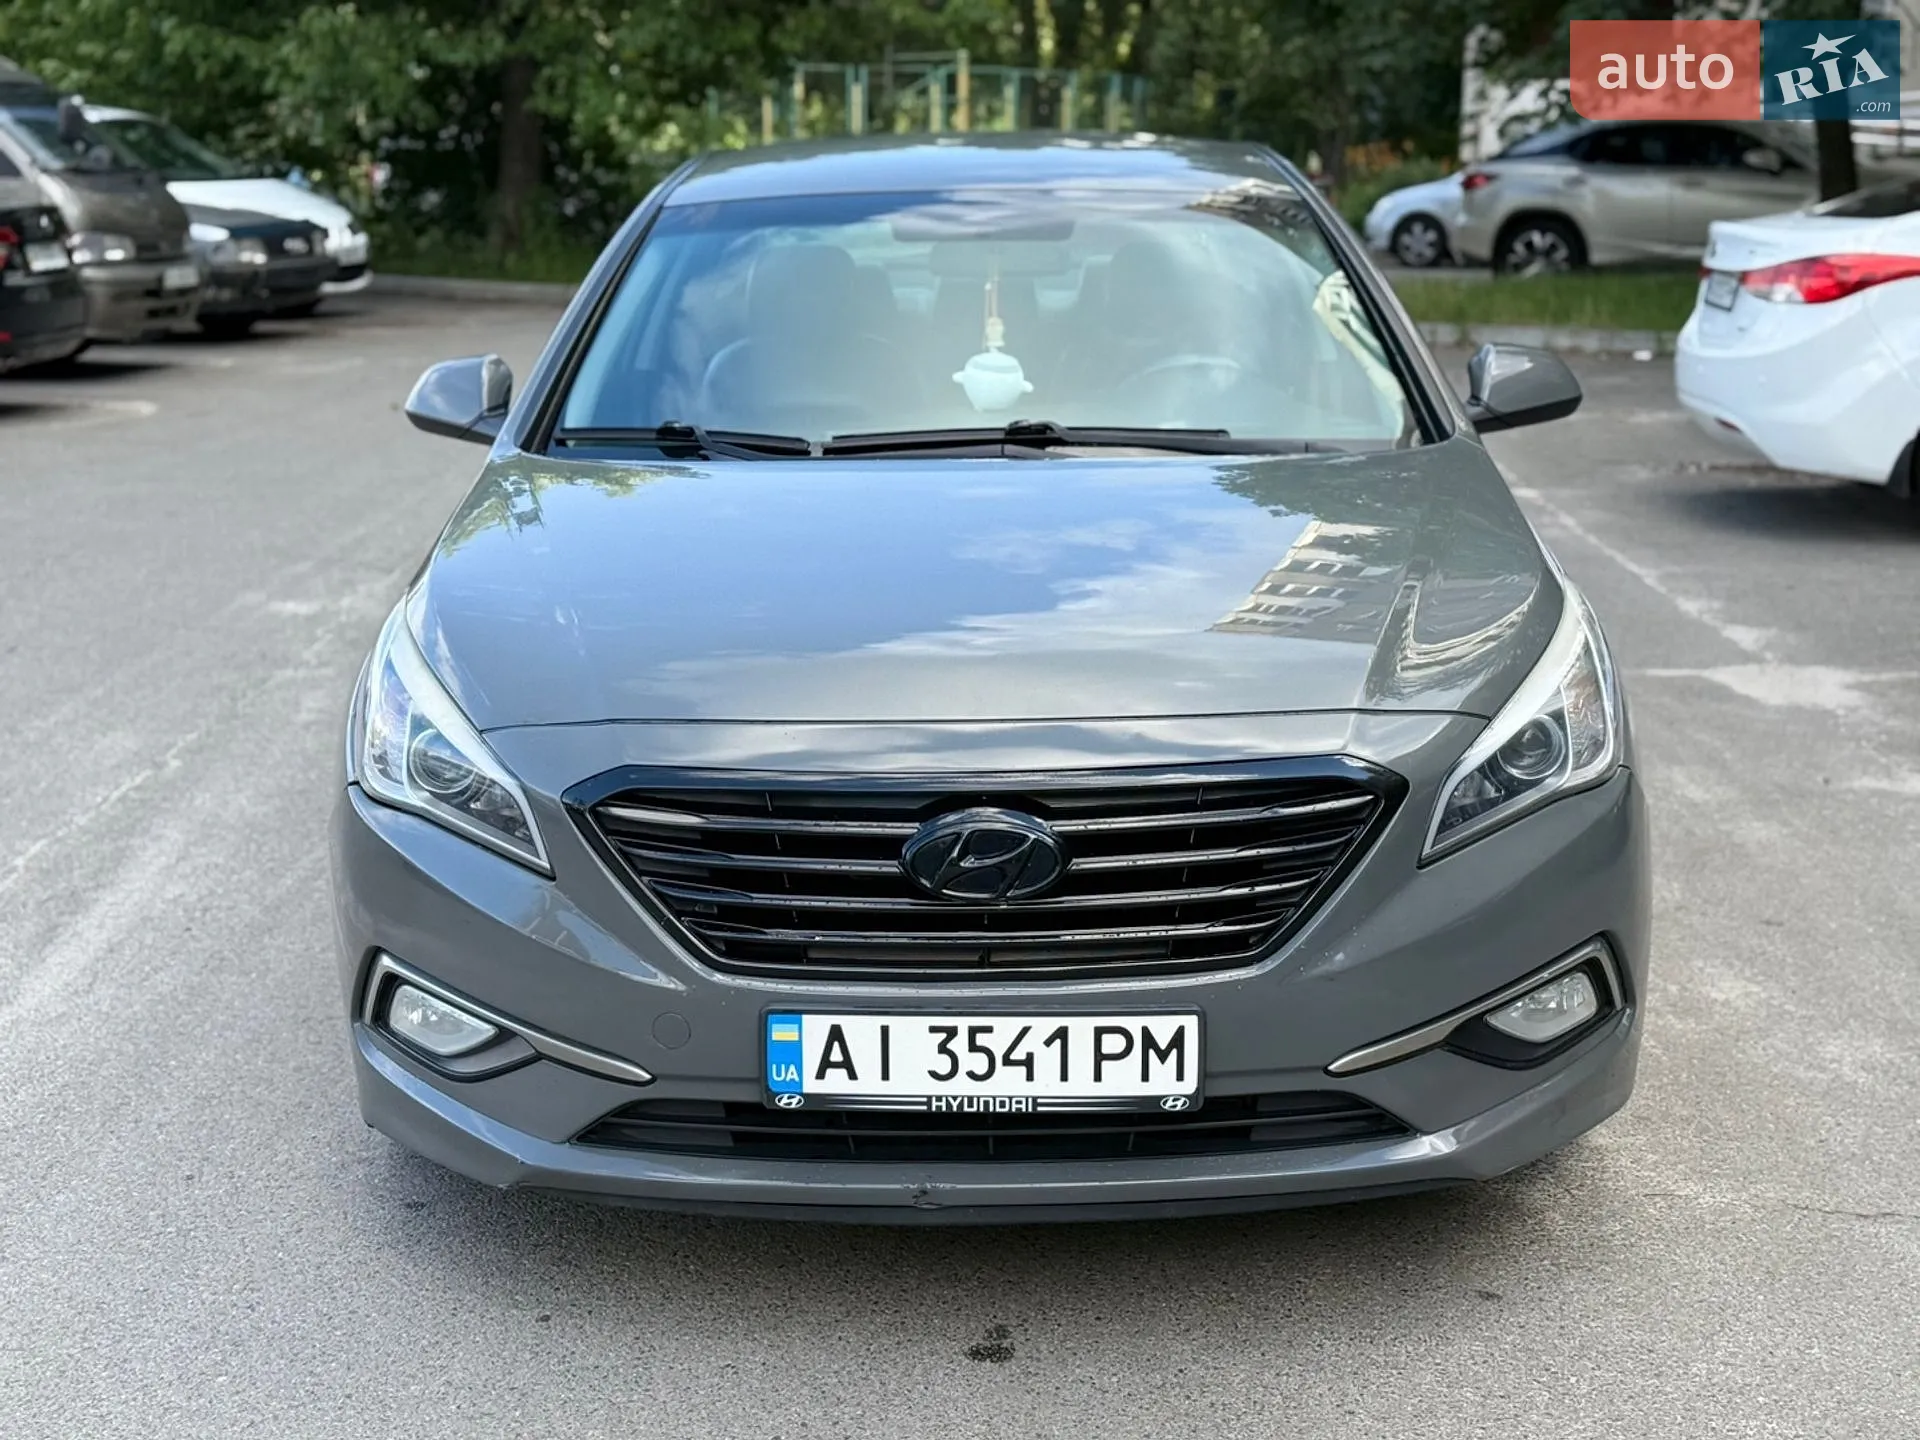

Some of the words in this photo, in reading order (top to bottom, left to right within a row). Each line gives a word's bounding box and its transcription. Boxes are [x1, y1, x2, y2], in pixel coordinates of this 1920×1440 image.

[815, 1024, 890, 1082] AI
[927, 1025, 1069, 1082] 3541
[1093, 1025, 1185, 1082] PM
[772, 1063, 799, 1082] UA
[931, 1096, 1033, 1112] HYUNDAI
